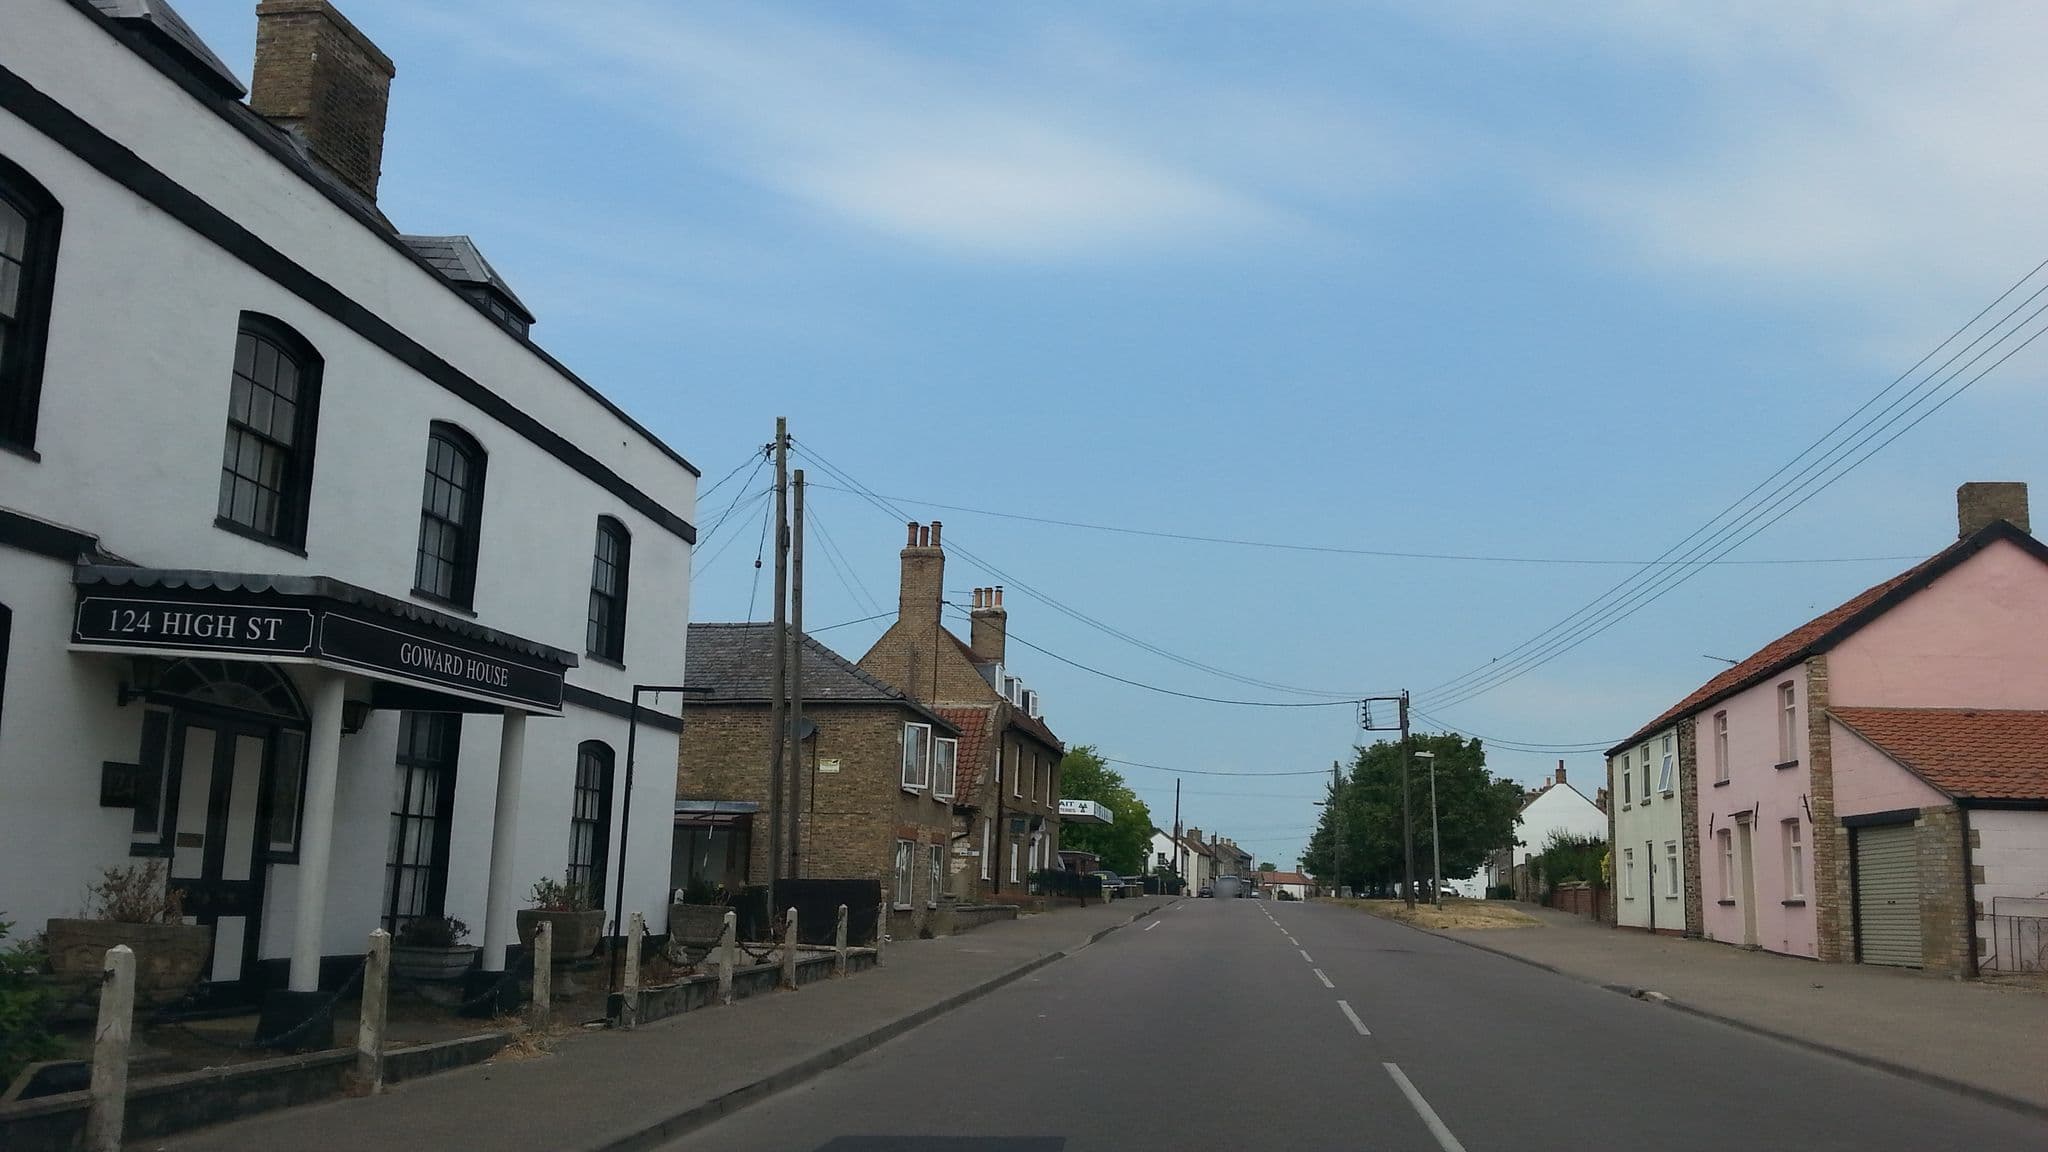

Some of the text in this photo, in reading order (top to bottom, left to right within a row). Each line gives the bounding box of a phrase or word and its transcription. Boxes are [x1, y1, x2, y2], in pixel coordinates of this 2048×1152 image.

[108, 609, 282, 641] 124 HIGH ST
[401, 643, 508, 687] GOWARD HOUSE
